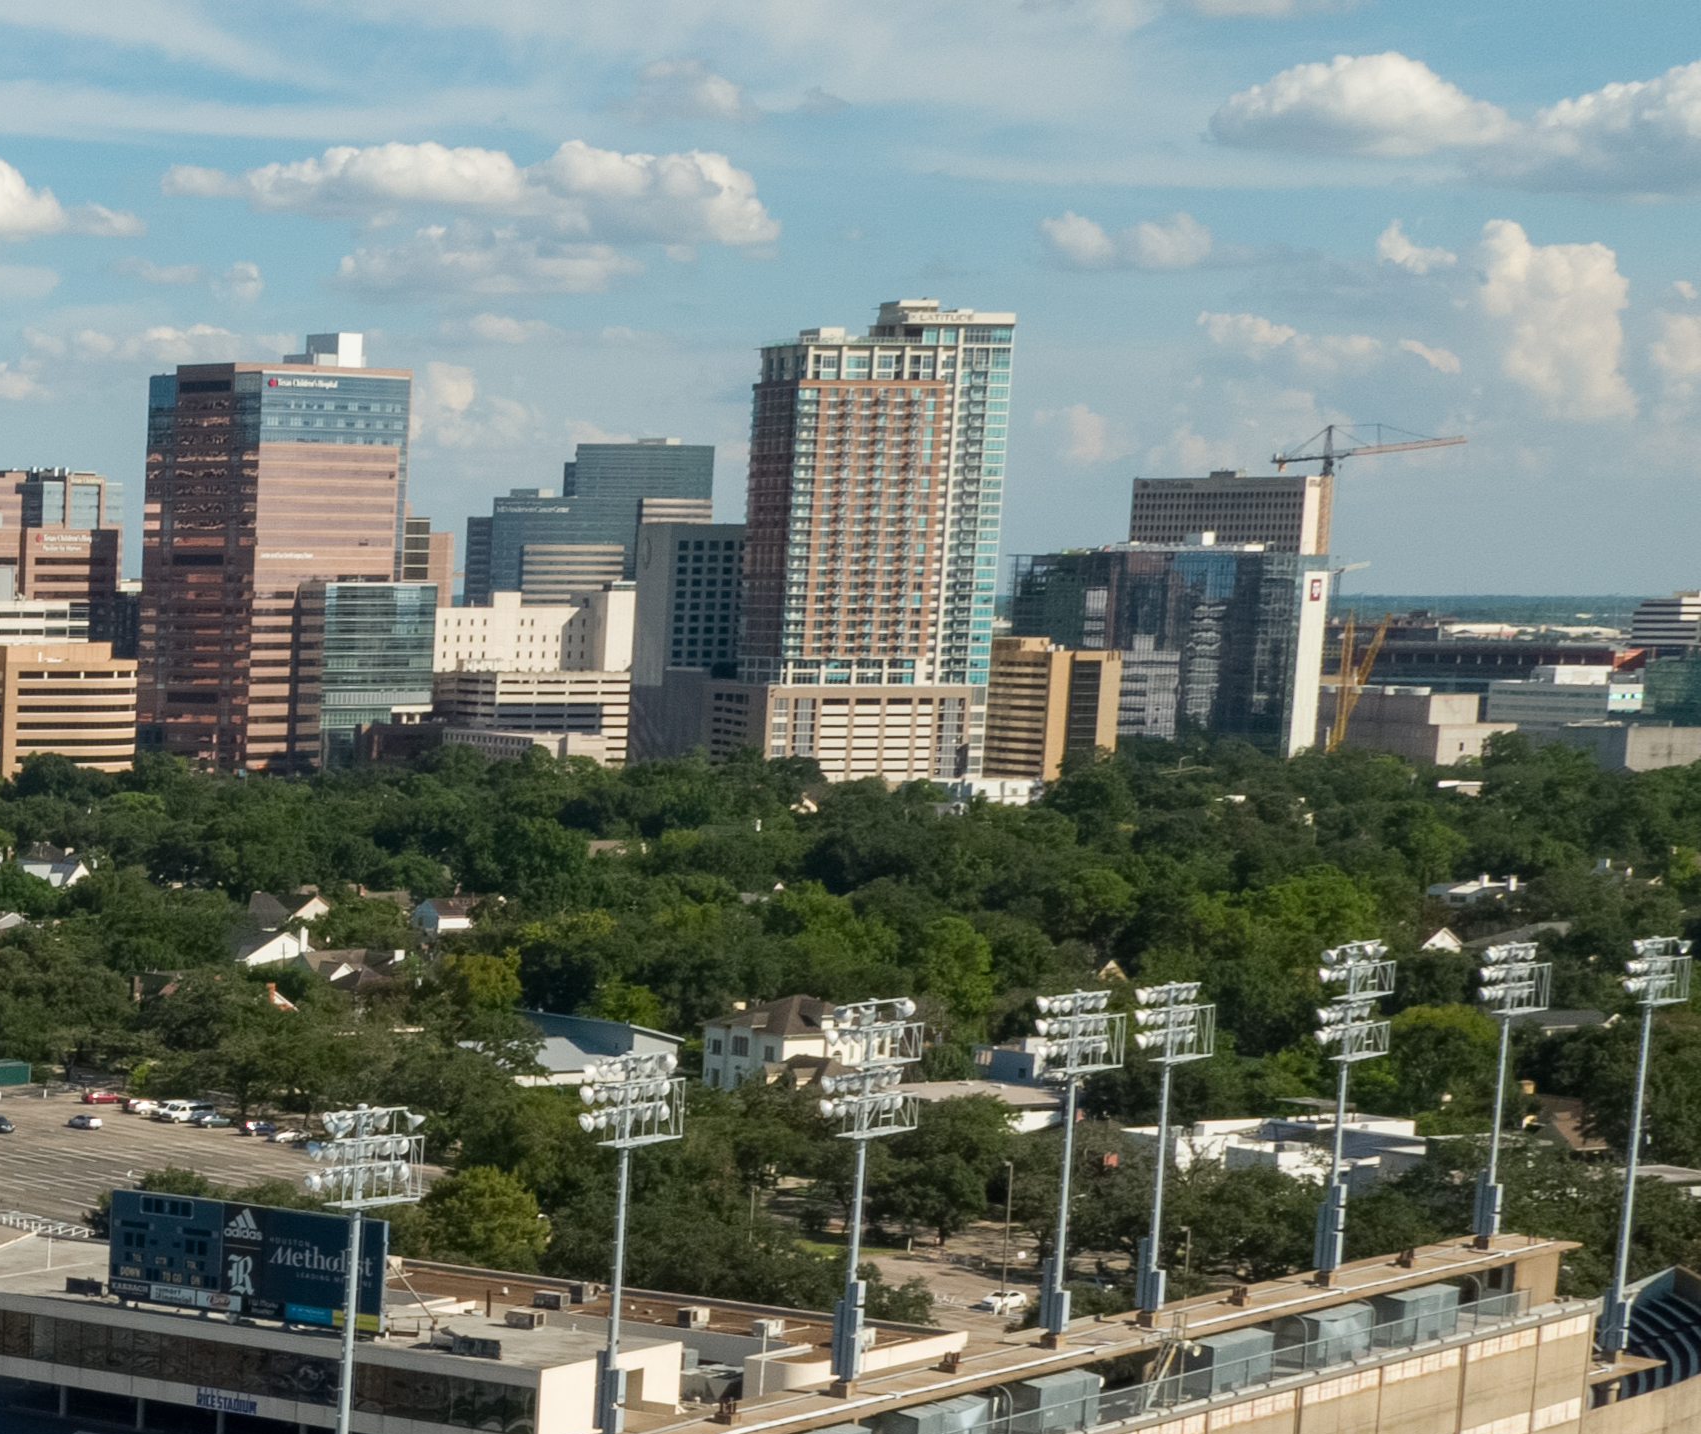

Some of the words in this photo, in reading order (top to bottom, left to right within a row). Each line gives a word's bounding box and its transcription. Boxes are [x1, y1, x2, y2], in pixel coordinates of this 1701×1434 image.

[919, 313, 975, 322] LATITUDE
[223, 1227, 263, 1241] adidas
[269, 1237, 311, 1248] HOUSTON
[269, 1246, 374, 1278] Methodst
[119, 1266, 141, 1278] DOWN
[295, 1271, 331, 1282] LEADING
[196, 1392, 216, 1408] RICE
